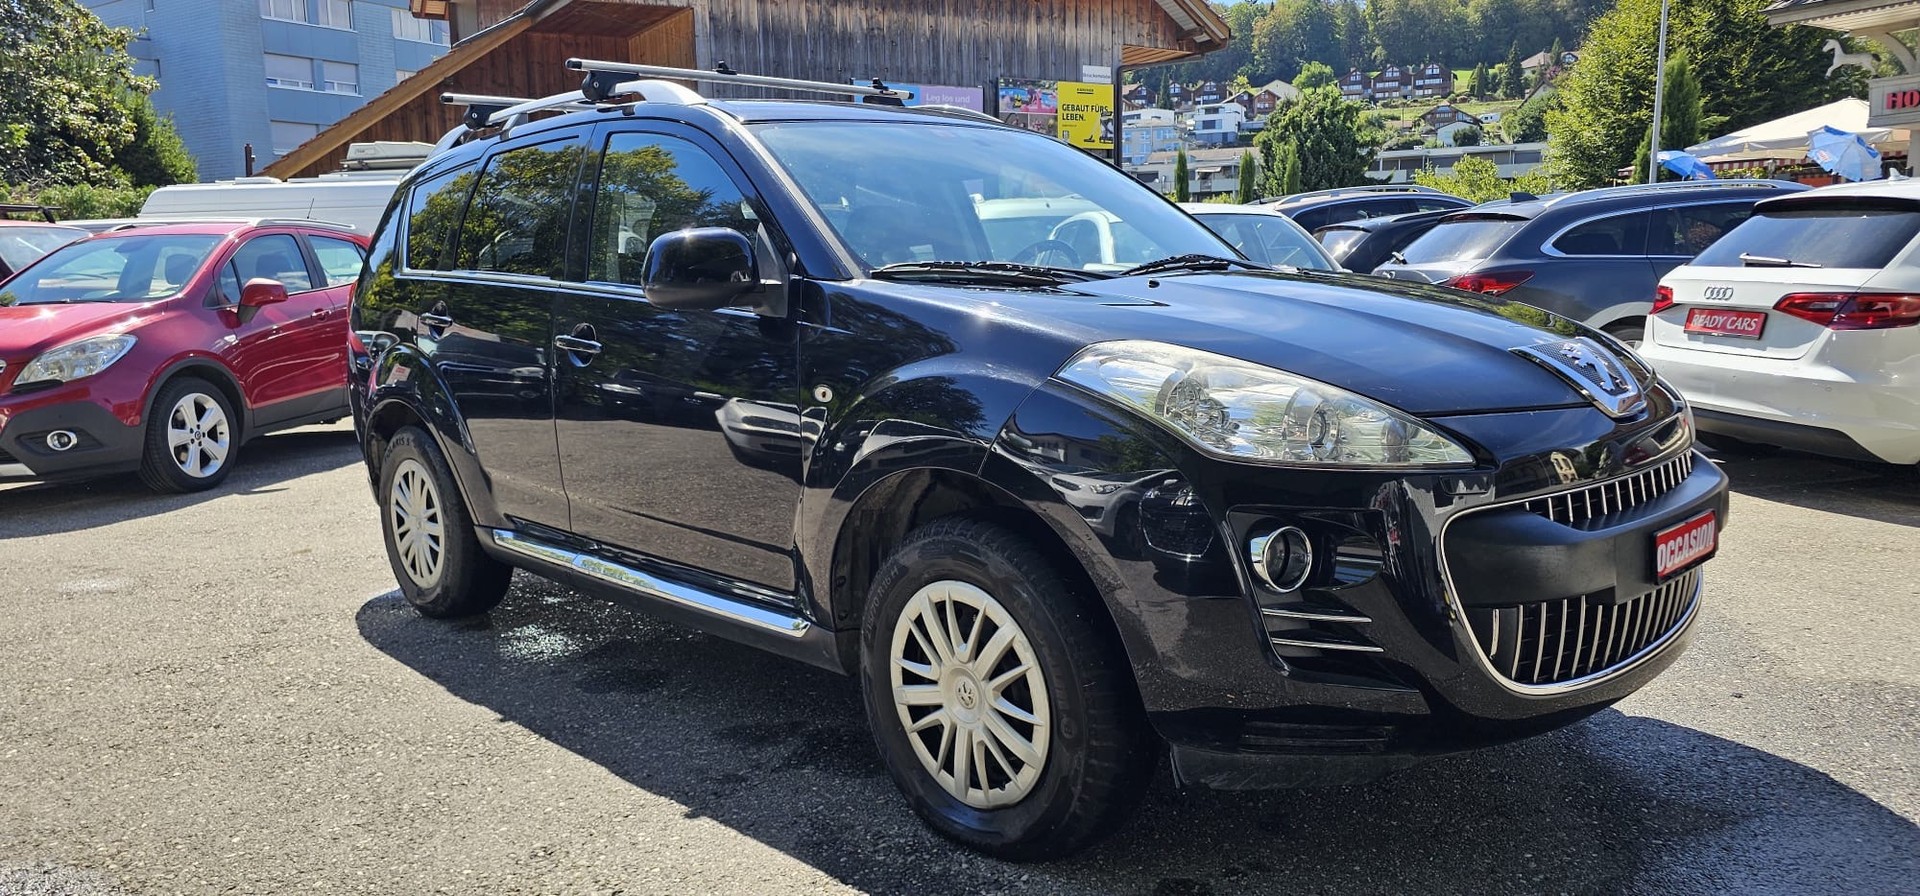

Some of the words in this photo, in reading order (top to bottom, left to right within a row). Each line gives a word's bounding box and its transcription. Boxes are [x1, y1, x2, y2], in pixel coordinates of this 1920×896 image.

[926, 93, 941, 104] Leg
[955, 95, 970, 104] und
[1062, 104, 1089, 112] GEBAUT
[1062, 113, 1086, 121] LEBEN.
[1691, 314, 1725, 328] READY
[1726, 316, 1758, 331] CARS
[1656, 521, 1715, 572] OCCASION
